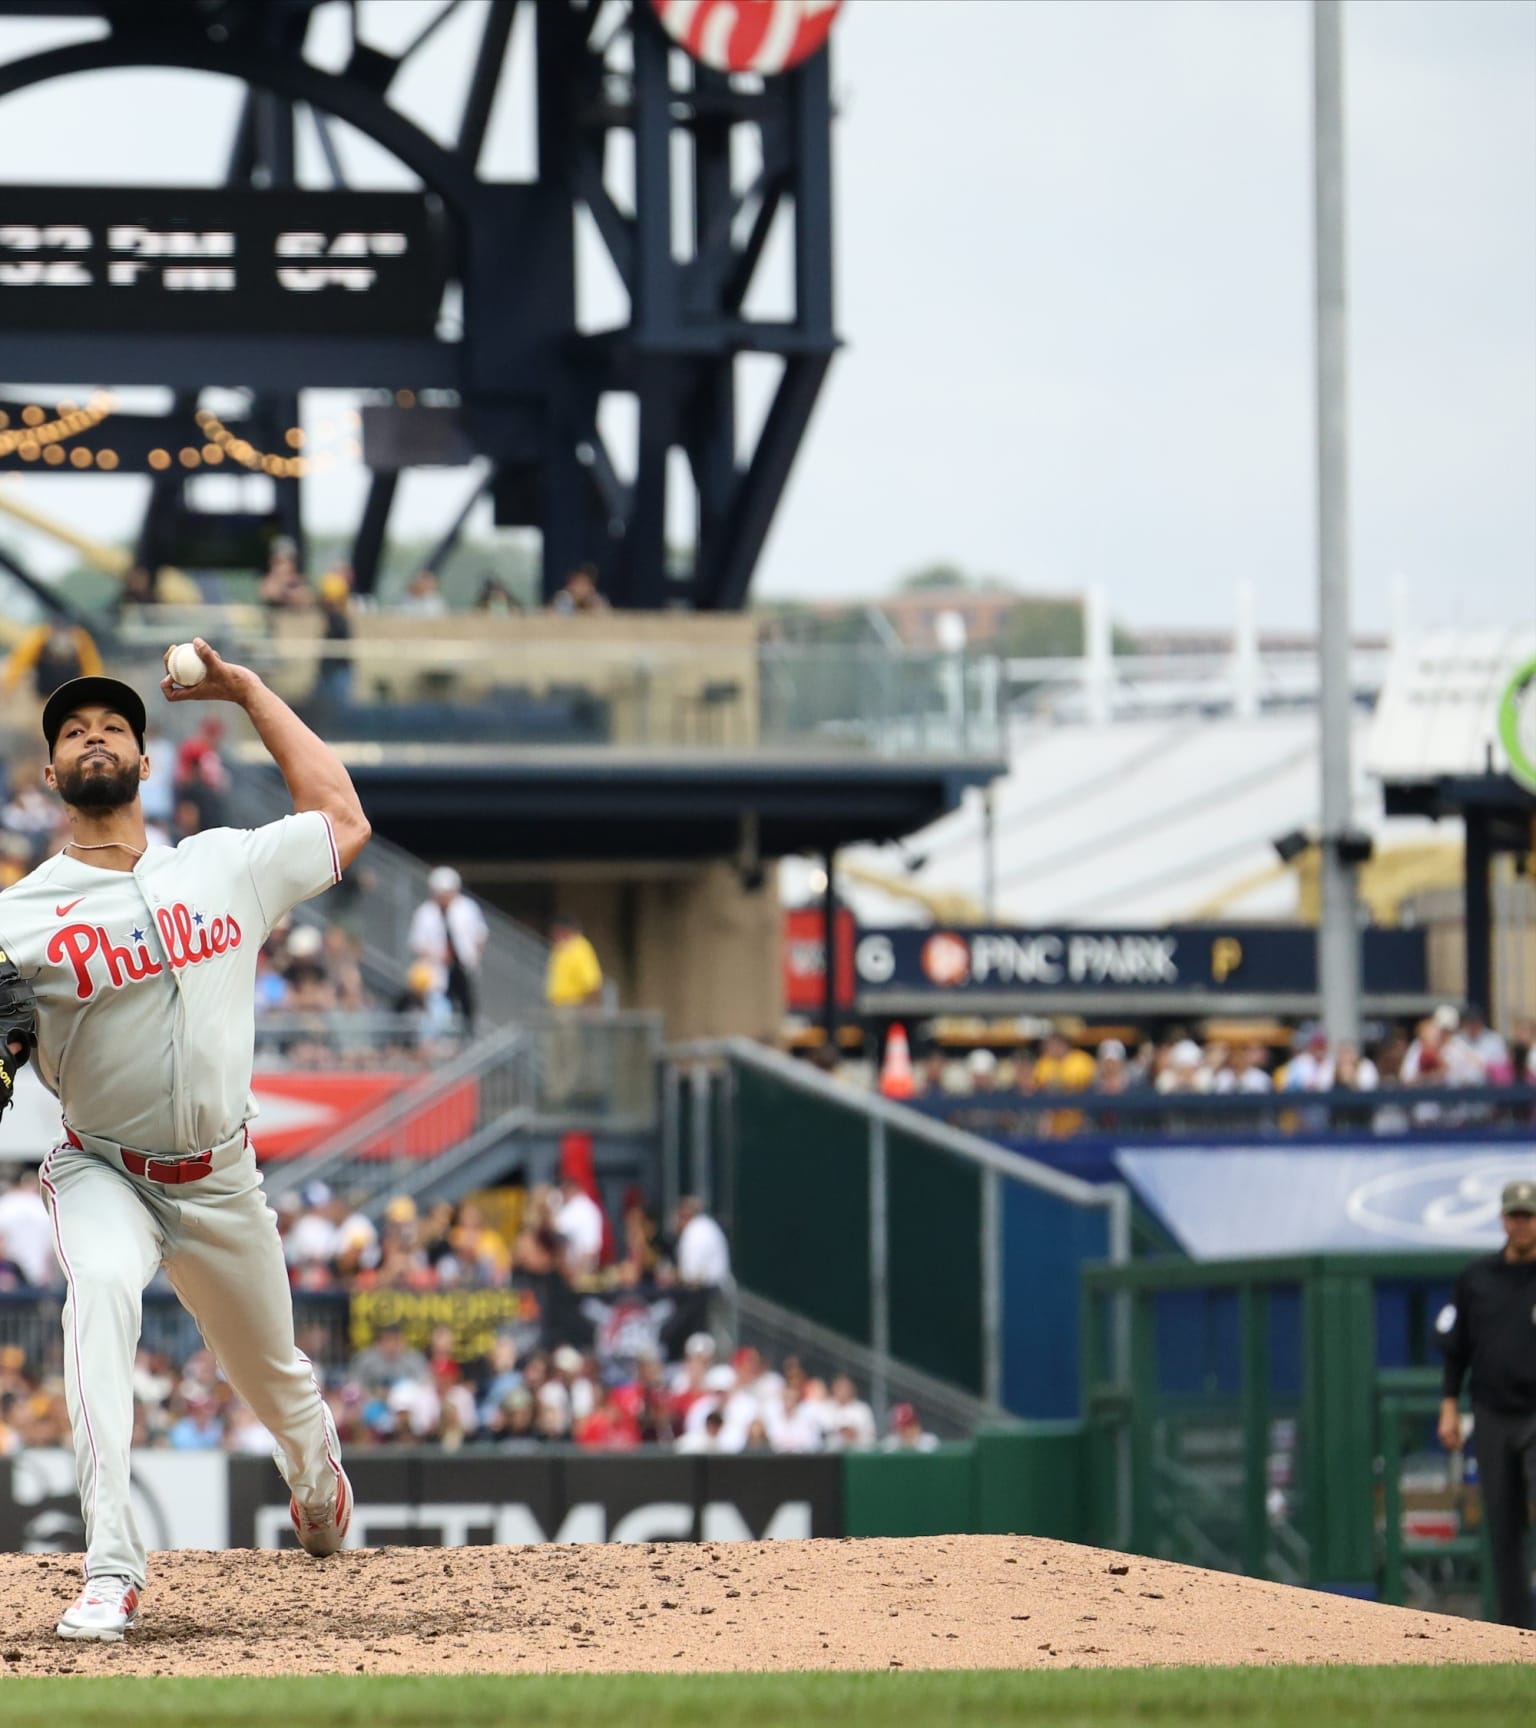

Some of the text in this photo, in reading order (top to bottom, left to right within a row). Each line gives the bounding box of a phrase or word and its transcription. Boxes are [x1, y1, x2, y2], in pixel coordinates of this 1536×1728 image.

[107, 226, 236, 291] PM
[46, 902, 242, 999] Phillies
[969, 933, 1179, 984] PNC PARK
